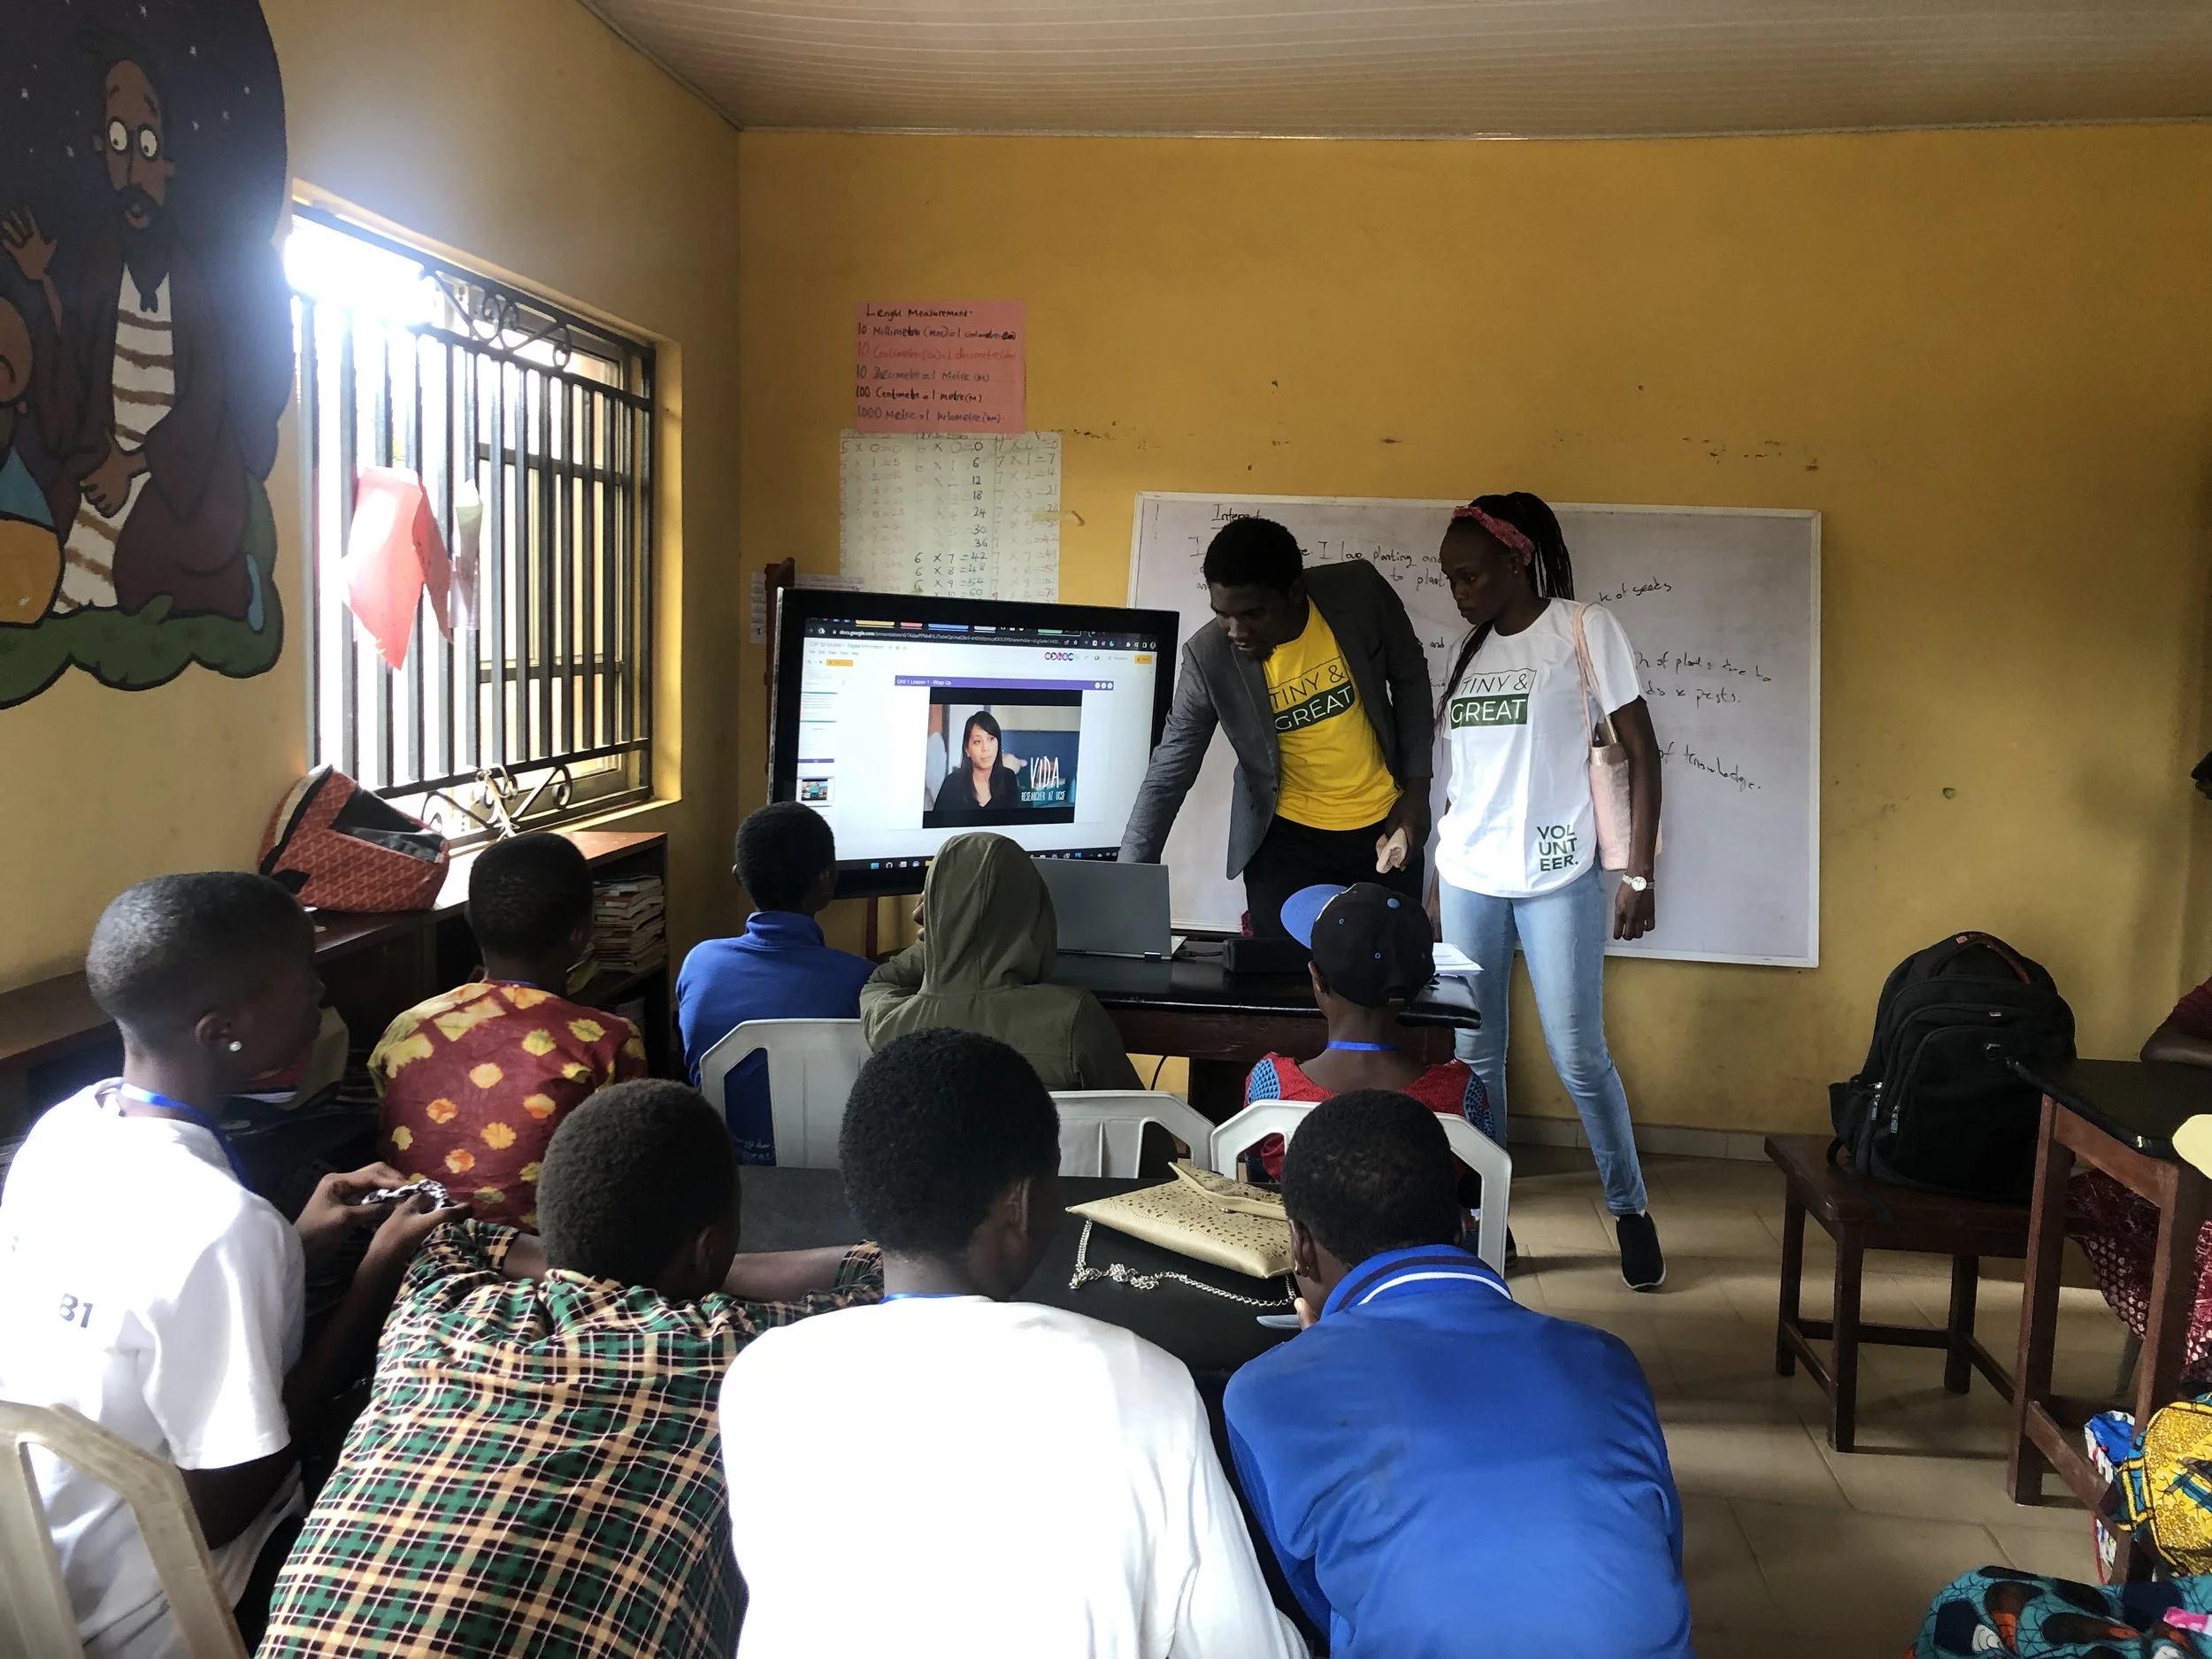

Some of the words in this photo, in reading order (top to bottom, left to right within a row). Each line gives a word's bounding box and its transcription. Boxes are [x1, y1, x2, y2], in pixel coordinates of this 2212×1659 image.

[856, 322, 867, 334] 10
[856, 342, 870, 357] 10
[856, 364, 867, 379] 10
[856, 386, 871, 398] 100
[857, 406, 882, 419] 1000
[973, 457, 980, 468] 6
[972, 475, 981, 485] 12
[974, 506, 986, 518] 24
[972, 524, 987, 534] 30
[974, 538, 988, 548] 36
[914, 552, 923, 564] 6
[948, 553, 955, 564] 7
[1318, 541, 1332, 559] I
[1373, 546, 1417, 568] planting
[915, 567, 924, 576] 6
[1390, 567, 1404, 581] to
[1417, 567, 1446, 591] plant
[914, 580, 924, 591] 6
[1430, 636, 1445, 648] and
[1657, 651, 1669, 669] of
[1269, 672, 1319, 709] TINY
[1328, 664, 1345, 683] &
[1462, 675, 1510, 695] TINY
[1513, 673, 1527, 691] &
[1275, 686, 1351, 730] GREAT
[1451, 699, 1526, 723] GREAT
[1031, 756, 1059, 788] VIDA
[1537, 825, 1575, 840] VOL
[1539, 837, 1578, 856] UNT
[1540, 854, 1578, 872] EER.
